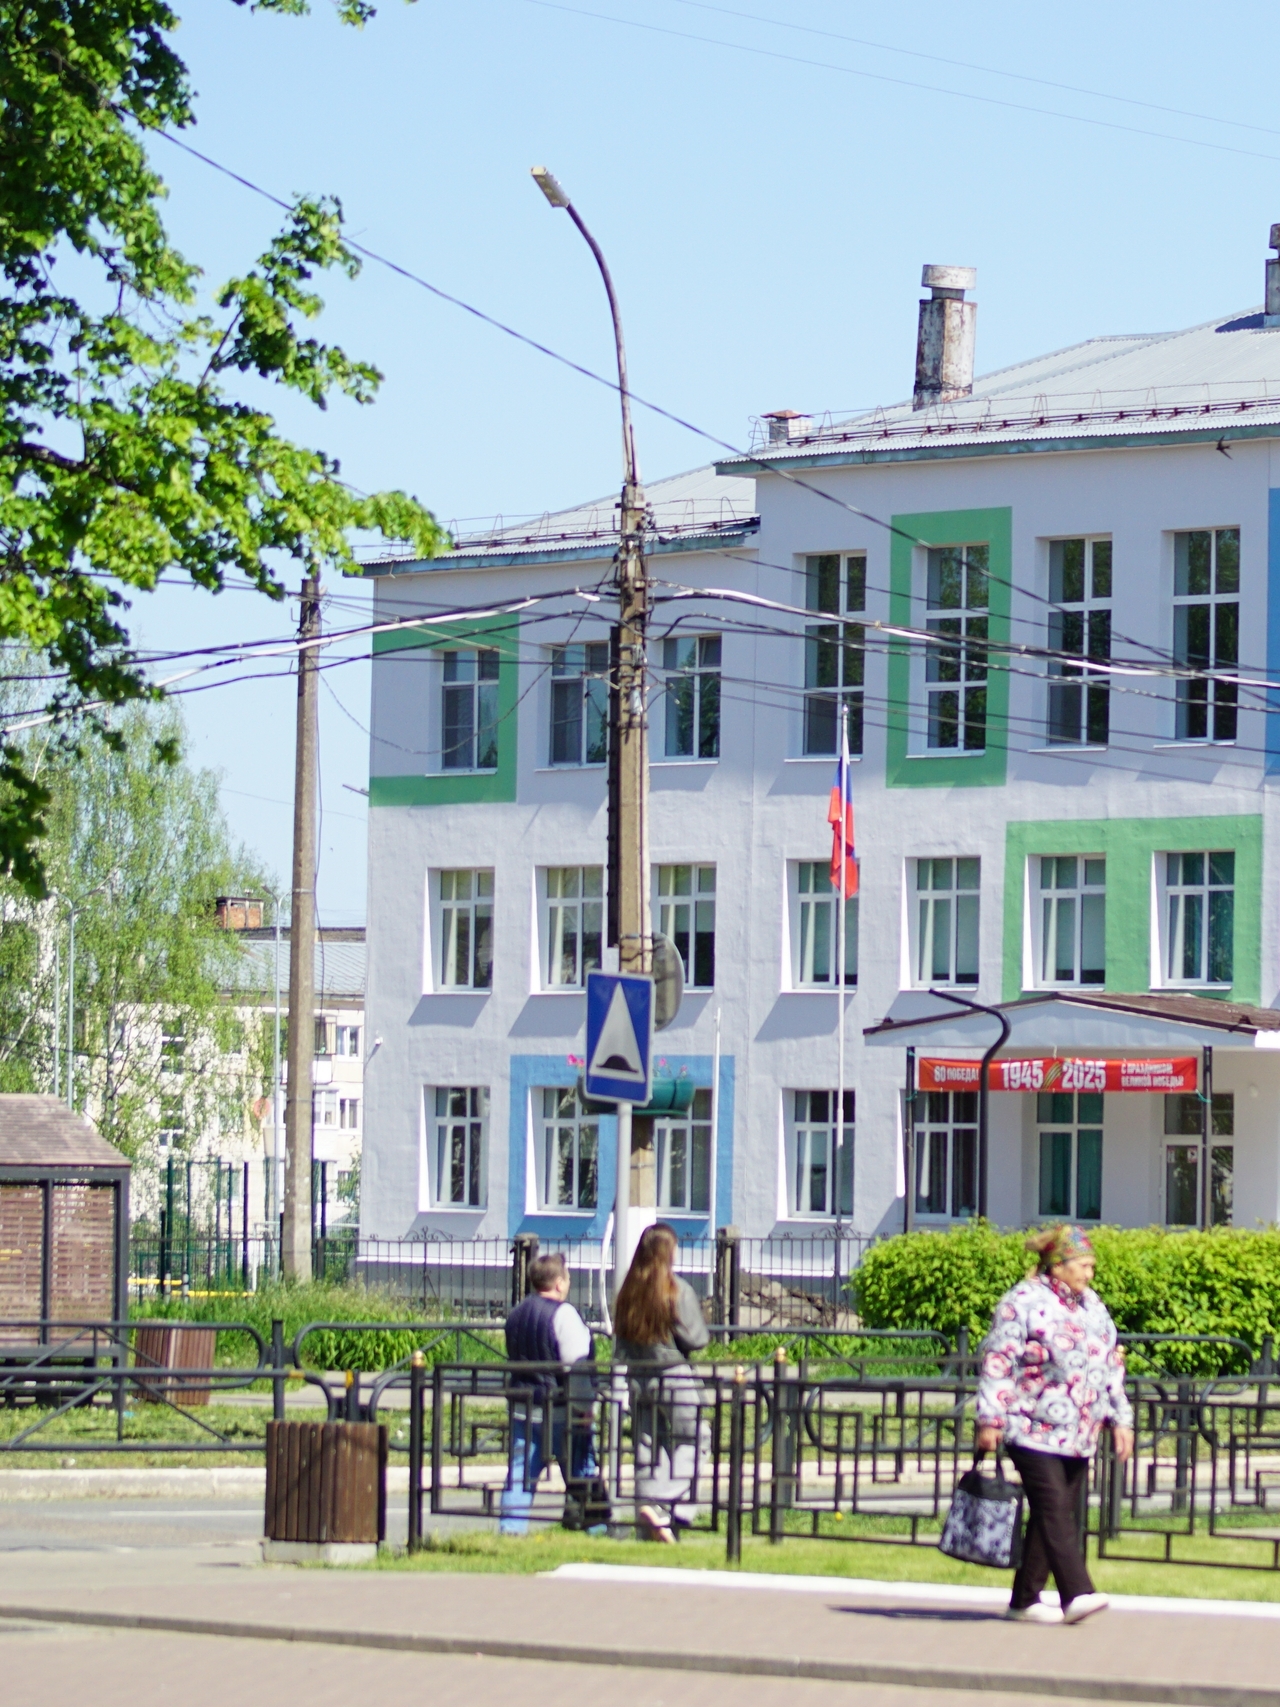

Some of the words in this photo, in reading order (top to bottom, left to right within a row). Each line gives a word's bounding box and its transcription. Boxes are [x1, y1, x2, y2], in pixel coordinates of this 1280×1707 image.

[947, 1067, 979, 1083] ПОБЕДА!
[1001, 1060, 1043, 1089] 1945
[1062, 1060, 1106, 1089] 2025
[1121, 1063, 1126, 1074] С
